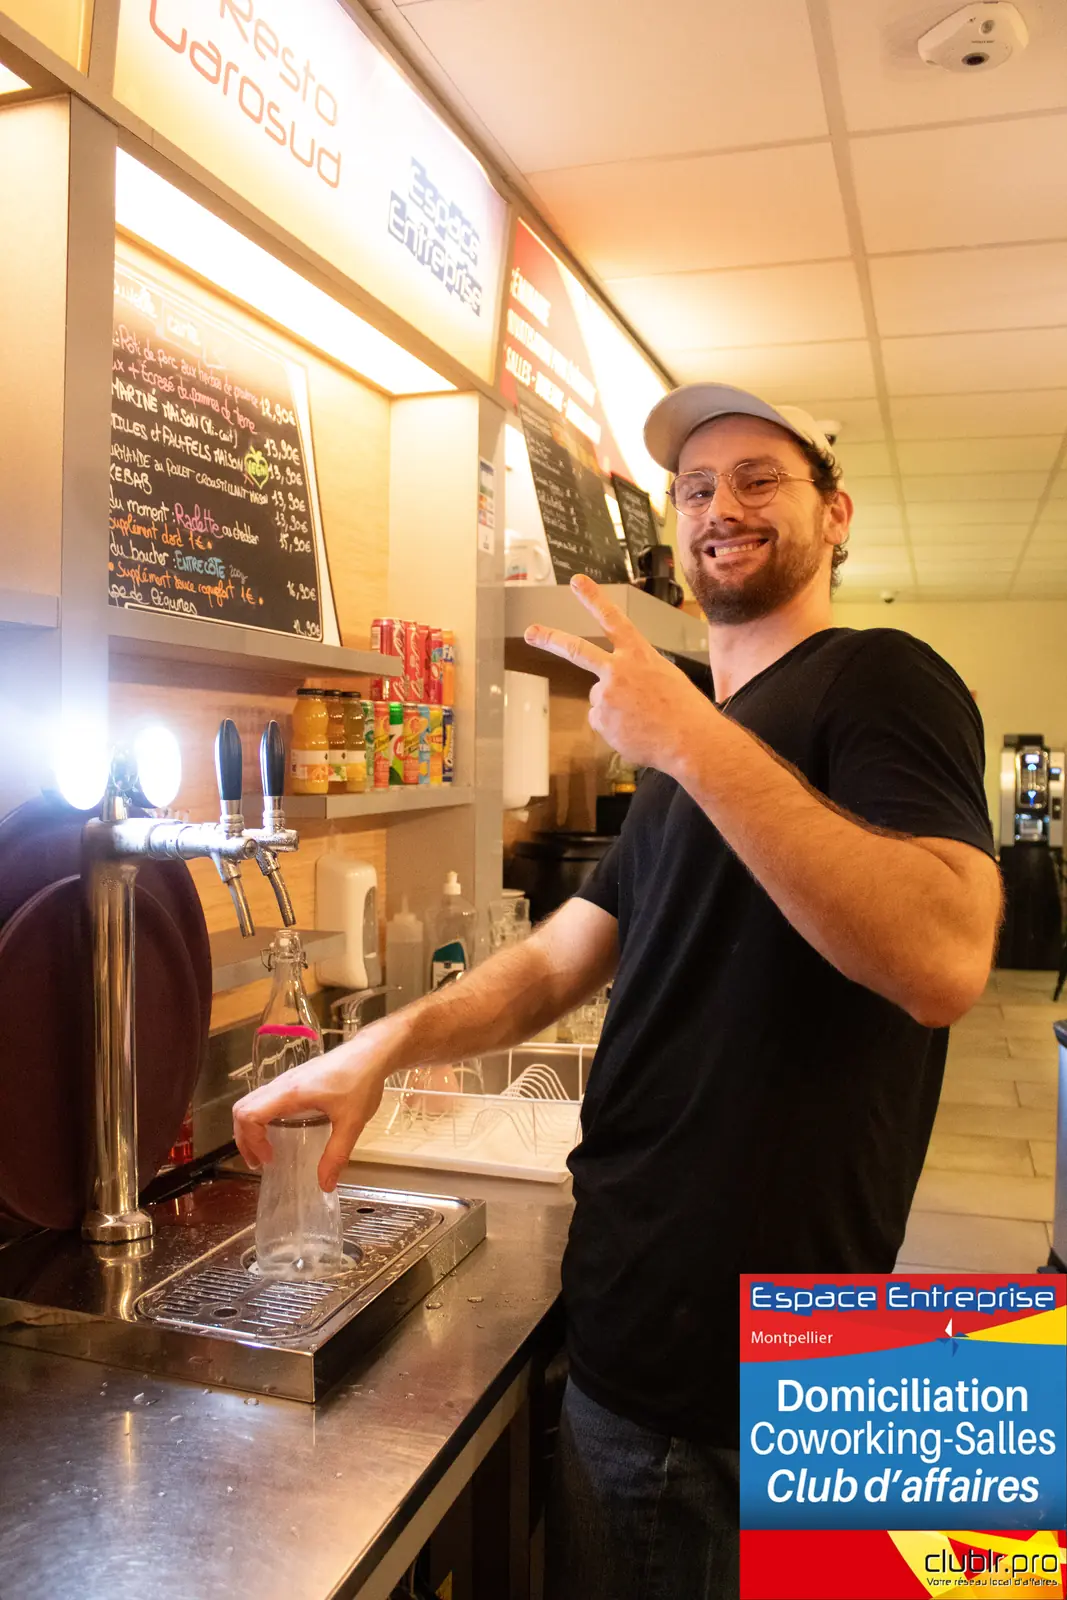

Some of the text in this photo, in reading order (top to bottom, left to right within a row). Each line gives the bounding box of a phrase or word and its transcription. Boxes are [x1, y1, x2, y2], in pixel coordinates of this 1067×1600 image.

[409, 163, 481, 261] Espace
[388, 198, 482, 315] Entreprise
[150, 422, 162, 443] et
[264, 438, 301, 466] 13,90€
[154, 459, 165, 473] au
[271, 489, 307, 512] 13,90€
[127, 500, 170, 522] moment
[279, 532, 312, 553] 15,90€
[274, 511, 309, 533] 13,90€
[110, 530, 128, 558] du
[129, 539, 170, 567] boucher
[116, 560, 172, 589] Supplément
